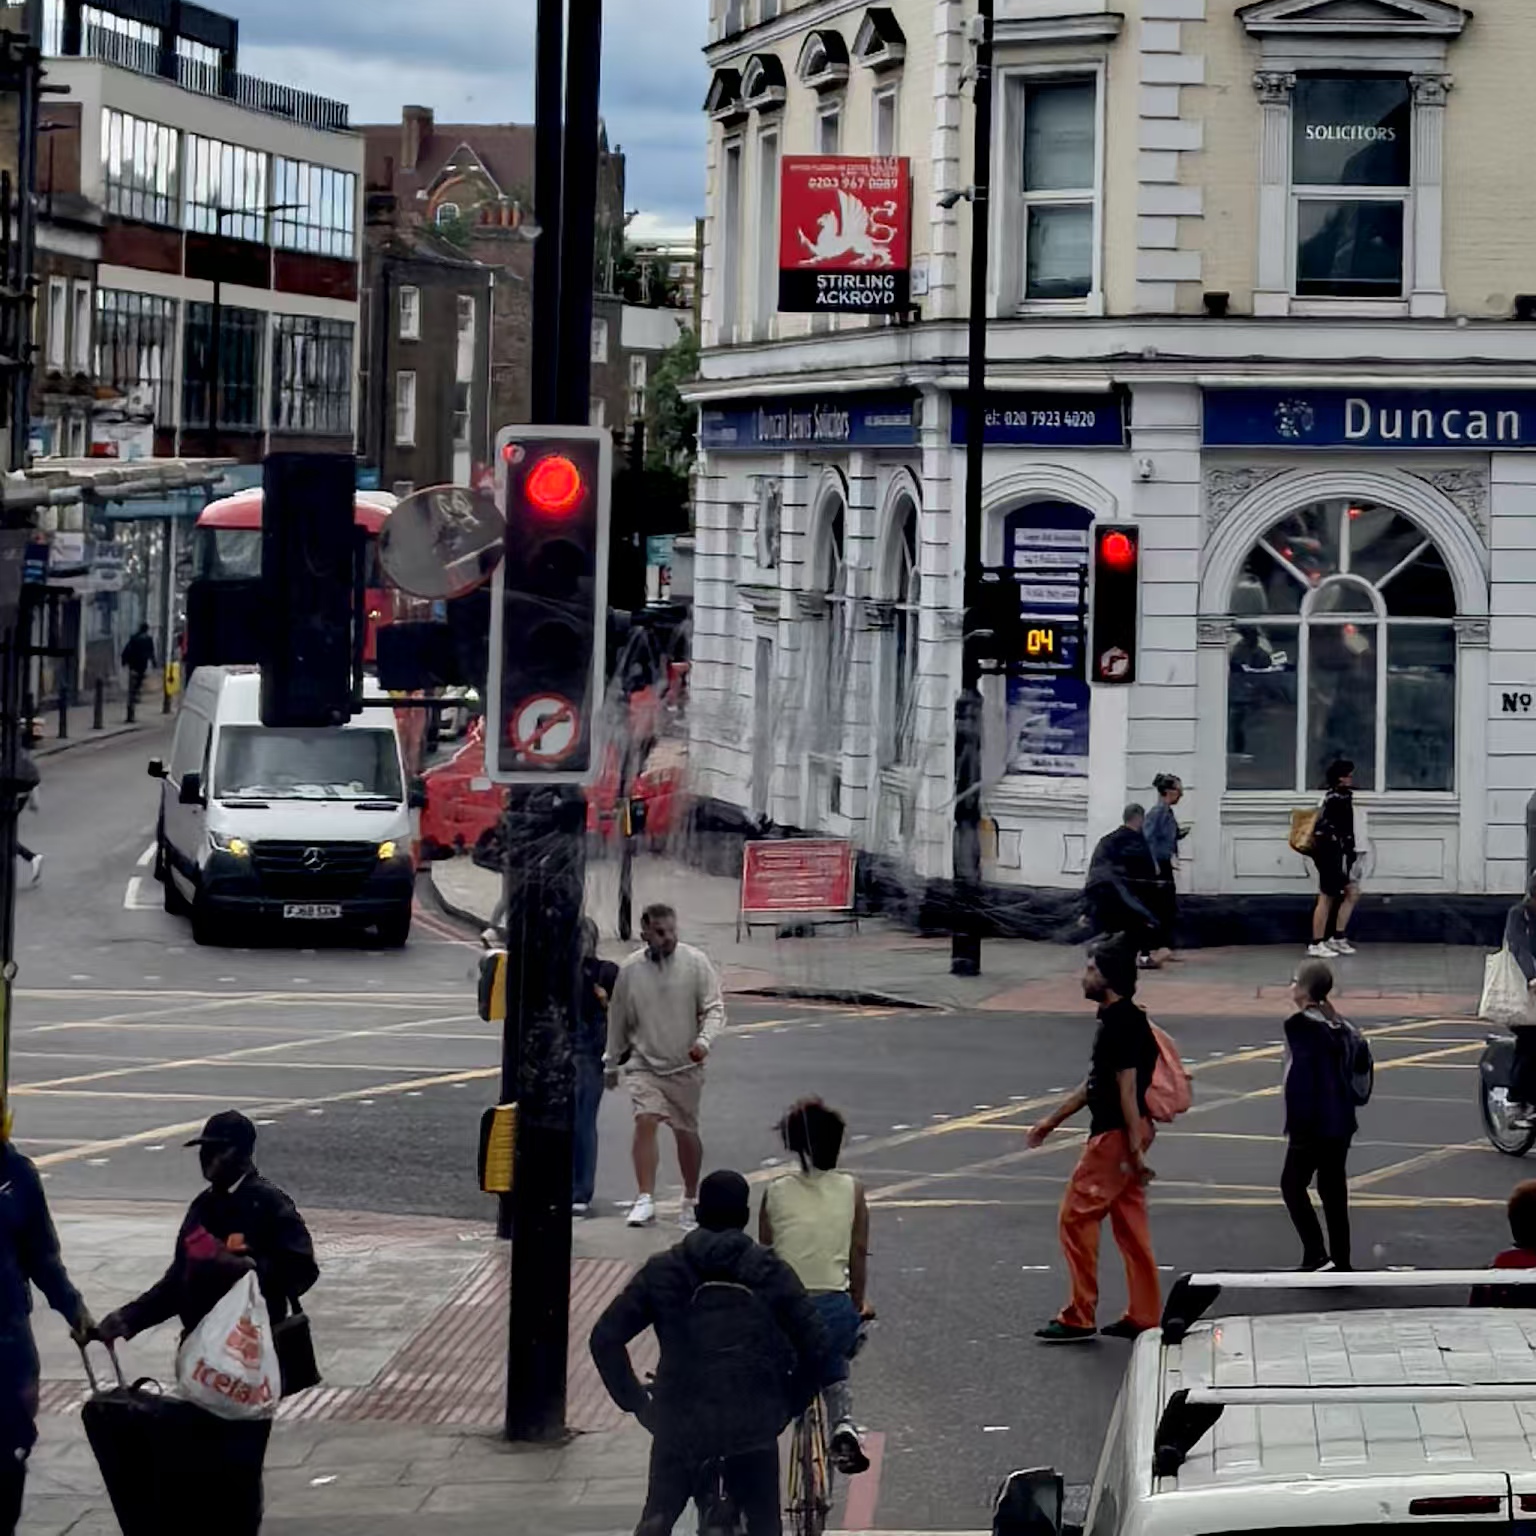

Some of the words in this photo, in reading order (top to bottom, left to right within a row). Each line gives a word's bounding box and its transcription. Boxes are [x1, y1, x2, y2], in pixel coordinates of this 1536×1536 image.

[1305, 125, 1396, 141] SOLICITORS
[817, 274, 895, 289] STIRLING
[816, 291, 895, 305] ACKROYD
[1004, 411, 1027, 426] 020
[1031, 411, 1060, 427] 7923
[1064, 411, 1095, 427] 4020
[1344, 398, 1520, 440] Duncan
[1027, 628, 1053, 653] 04
